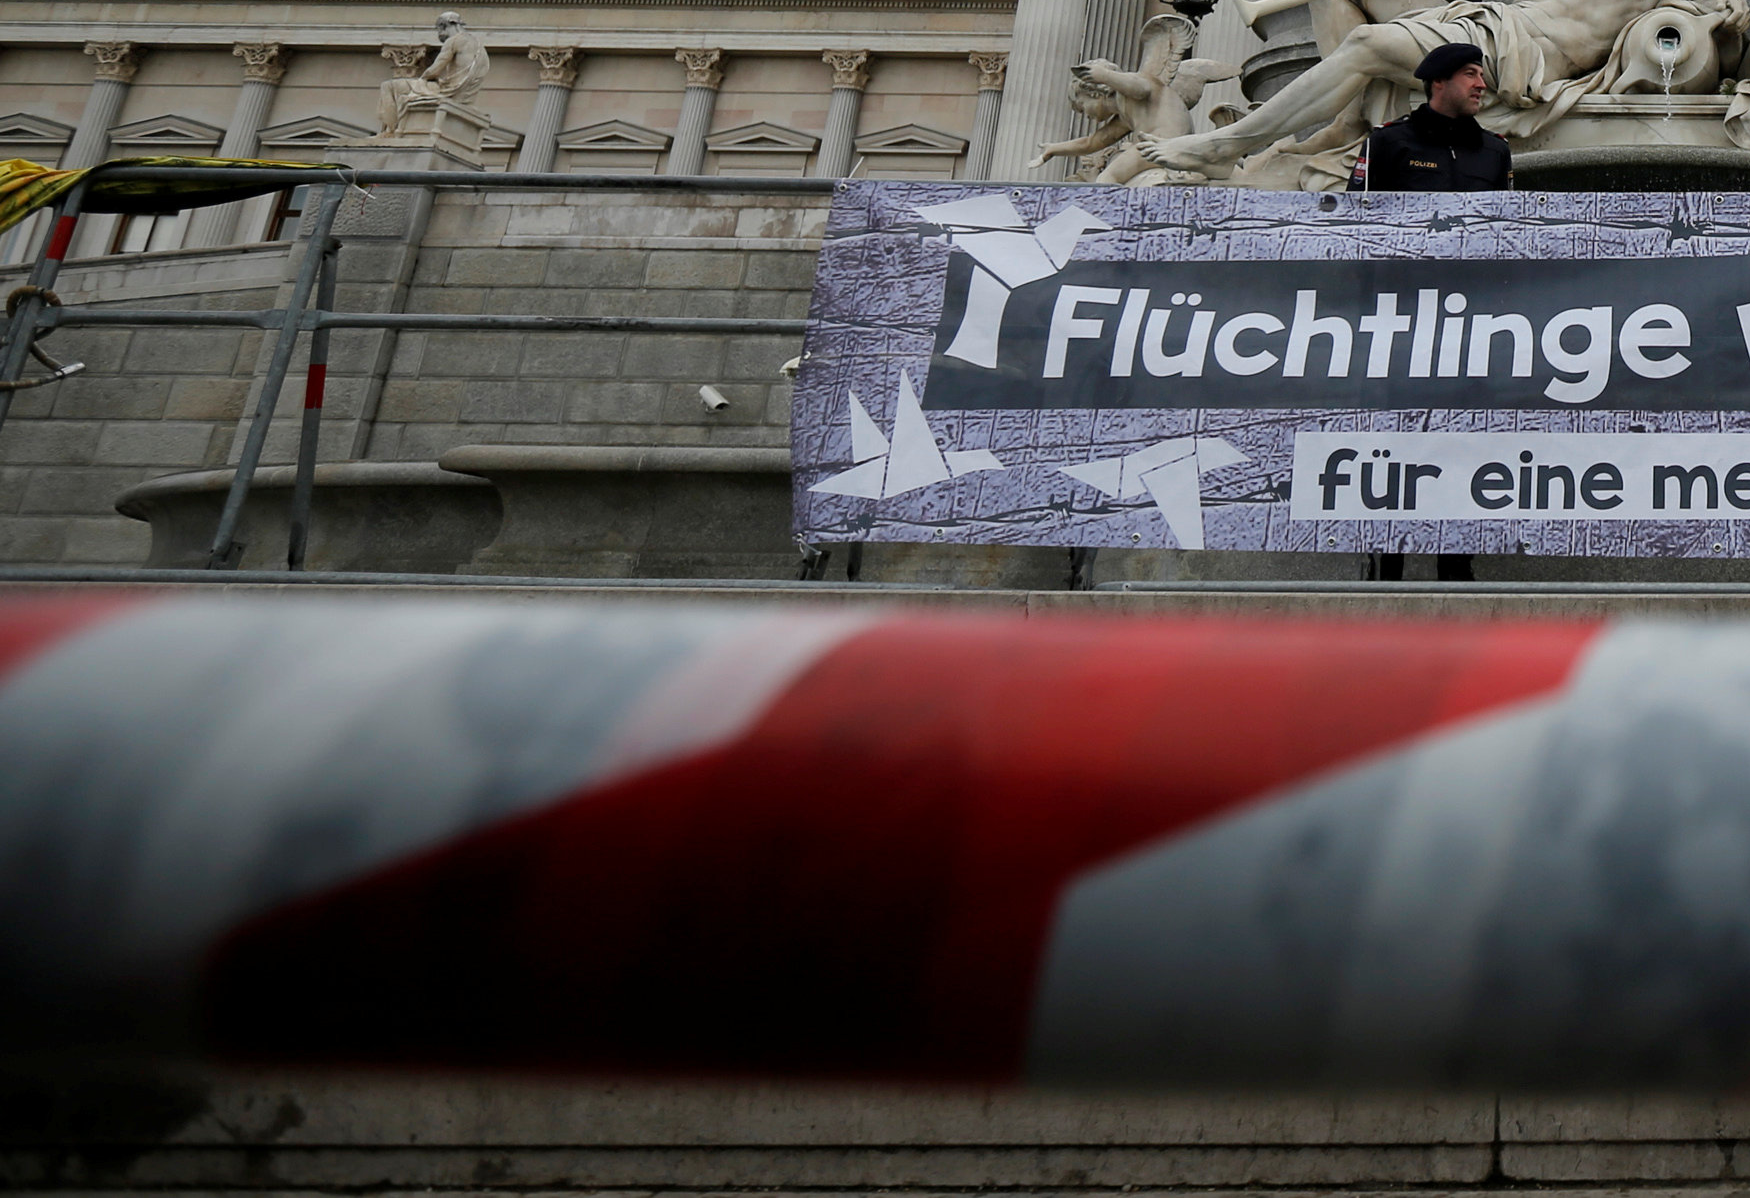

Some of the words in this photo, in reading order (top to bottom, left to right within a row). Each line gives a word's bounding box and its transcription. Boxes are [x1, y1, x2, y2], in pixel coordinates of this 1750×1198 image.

[1409, 160, 1438, 168] POLIZEI
[1043, 285, 1691, 404] Flüchtlinge
[1319, 447, 1443, 511] für
[1470, 450, 1624, 510] eine
